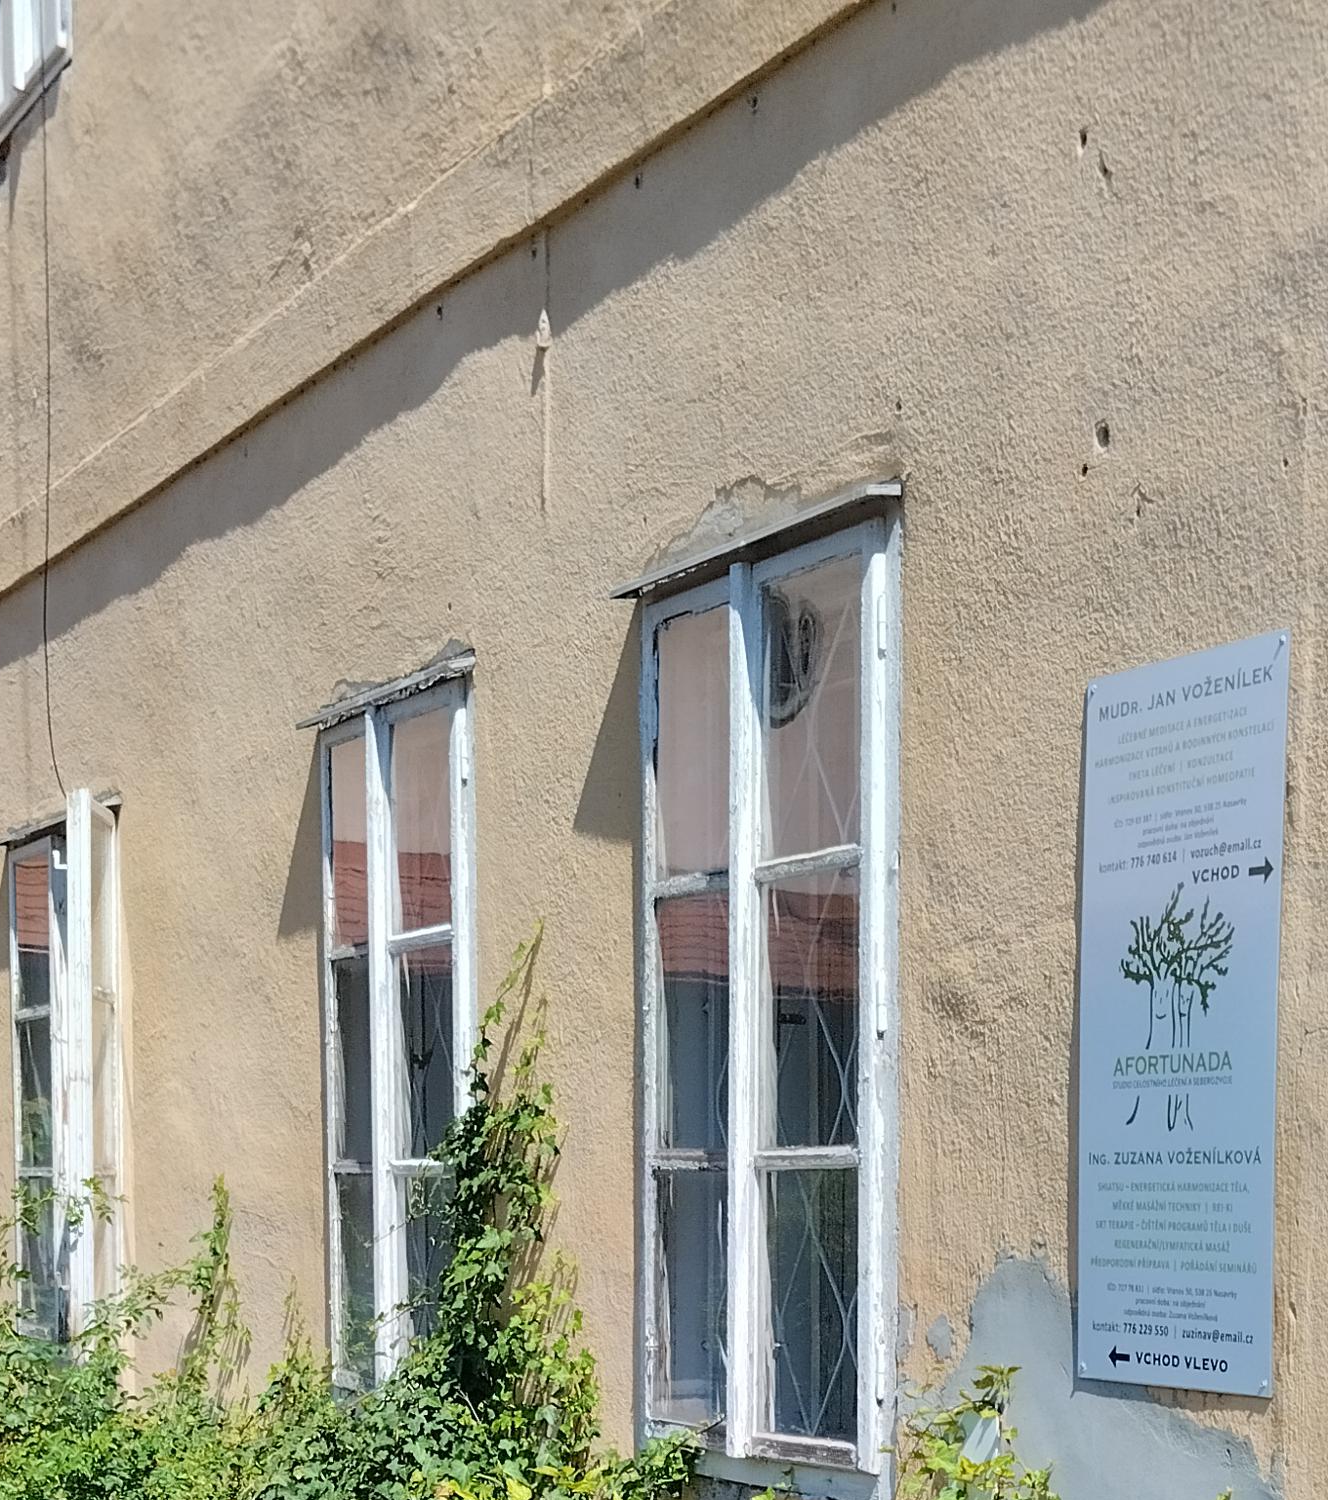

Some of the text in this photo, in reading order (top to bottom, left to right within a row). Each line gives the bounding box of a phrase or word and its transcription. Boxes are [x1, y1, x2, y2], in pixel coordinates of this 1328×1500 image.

[1148, 692, 1176, 711] JAN
[1182, 664, 1273, 701] VOŽENÍLEK
[1186, 719, 1191, 728] A
[1175, 741, 1181, 751] A
[1099, 858, 1128, 872] kontakt:
[1146, 854, 1160, 865] 740
[1163, 851, 1176, 862] 614
[1192, 865, 1240, 885] VCHOD
[1113, 1051, 1232, 1077] AFORTUNADA
[1114, 1151, 1163, 1165] ZUZANA
[1168, 1146, 1262, 1165] VOŽENÍLKOVÁ
[1108, 1220, 1134, 1229] TERAPIE
[1141, 1219, 1166, 1230] ČIŠTĚNÍ
[1168, 1219, 1208, 1232] PROGRAMŮ
[1210, 1220, 1226, 1232] TĚLA
[1233, 1220, 1252, 1233] DUŠE
[1206, 1239, 1230, 1252] MASÁŽ
[1092, 1320, 1254, 1345] kontakt: 776 229 550 zuzinav@email.cz
[1136, 1351, 1228, 1373] VCHOD VLEVO
